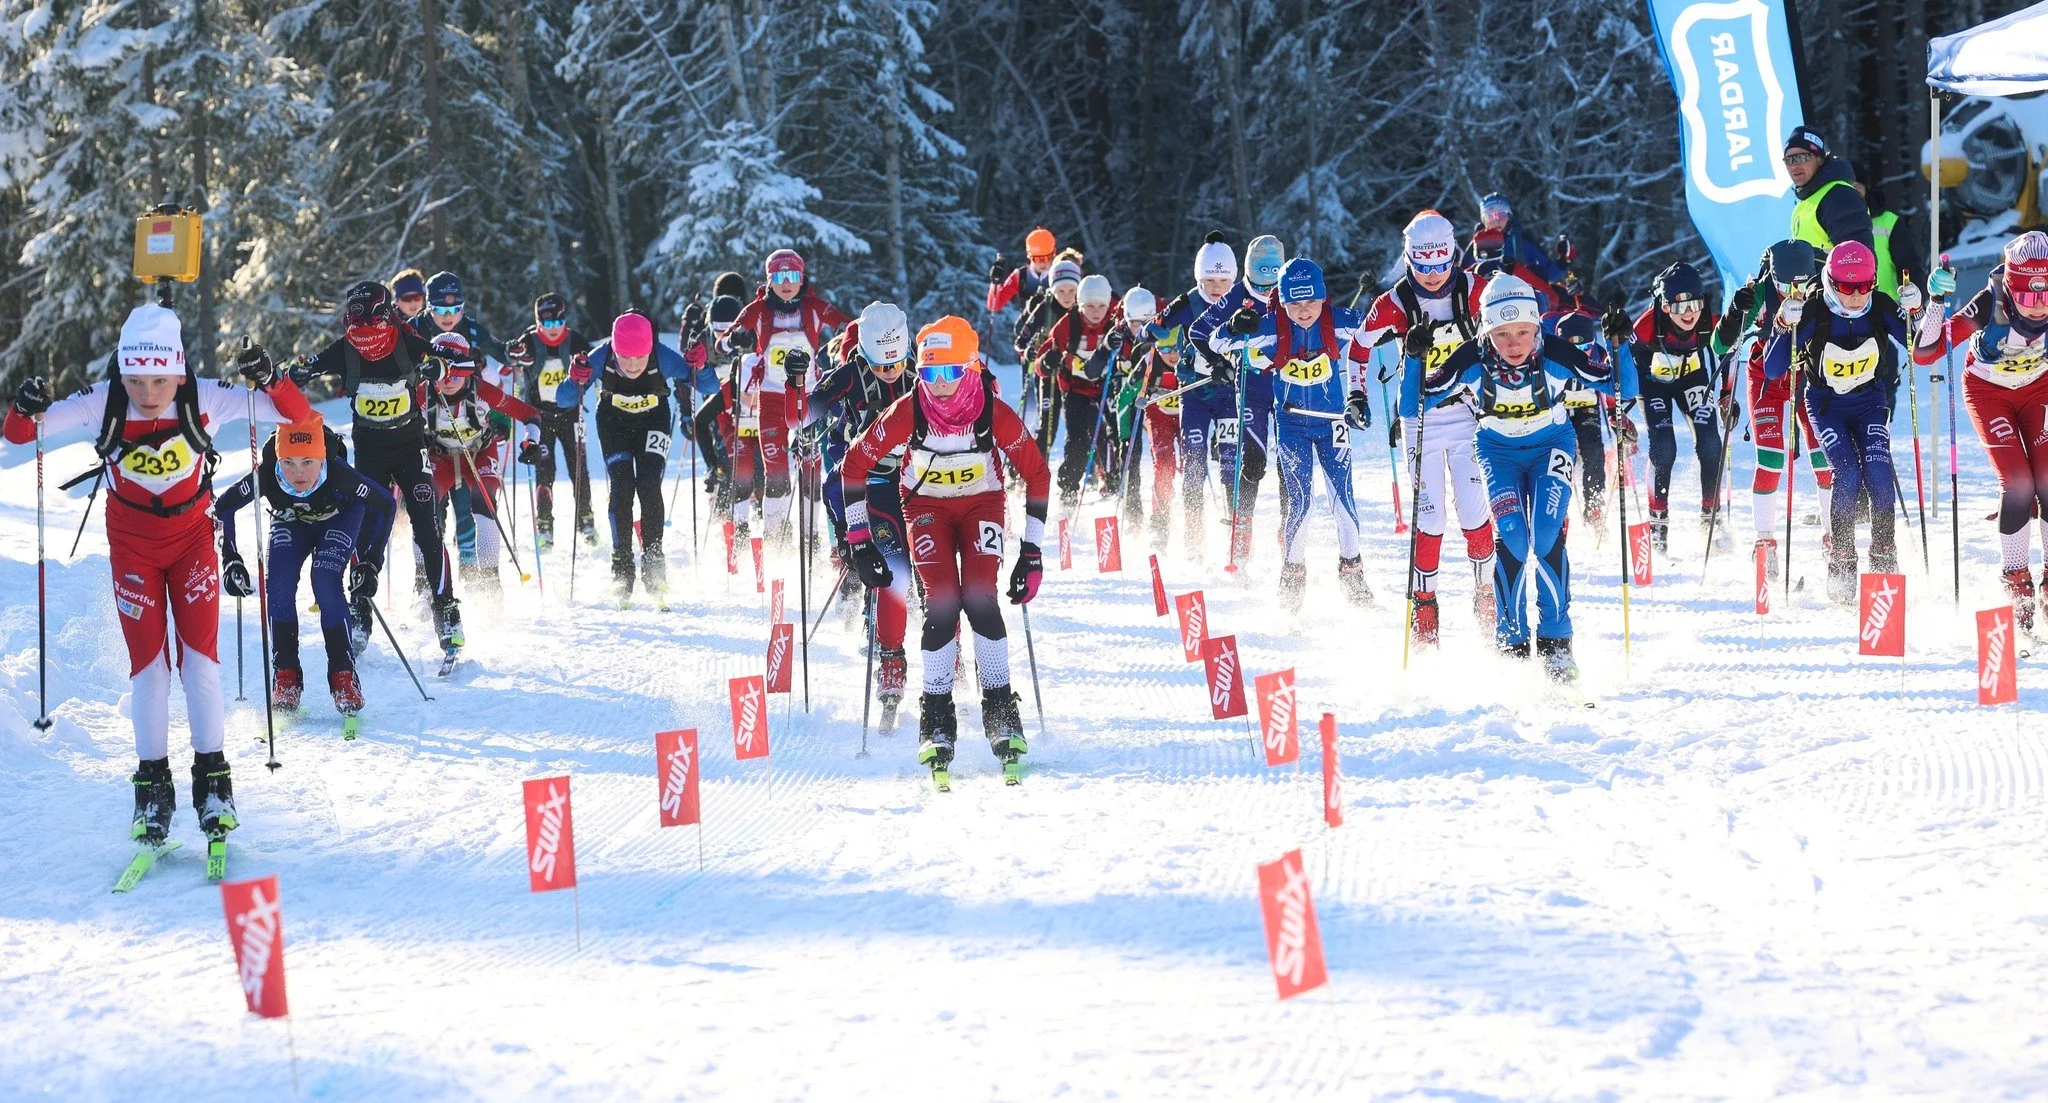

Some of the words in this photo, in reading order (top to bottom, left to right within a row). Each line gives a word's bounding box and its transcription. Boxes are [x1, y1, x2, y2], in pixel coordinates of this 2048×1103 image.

[1411, 247, 1449, 260] LYN
[2018, 265, 2048, 274] HASLUM
[124, 357, 168, 367] LYN
[1288, 362, 1323, 379] 218
[1832, 357, 1870, 377] 217
[365, 398, 401, 416] 227
[132, 449, 181, 476] 233
[928, 467, 975, 484] 215
[185, 570, 218, 605] LYN
[204, 590, 217, 602] SKI
[119, 586, 156, 608] sportful
